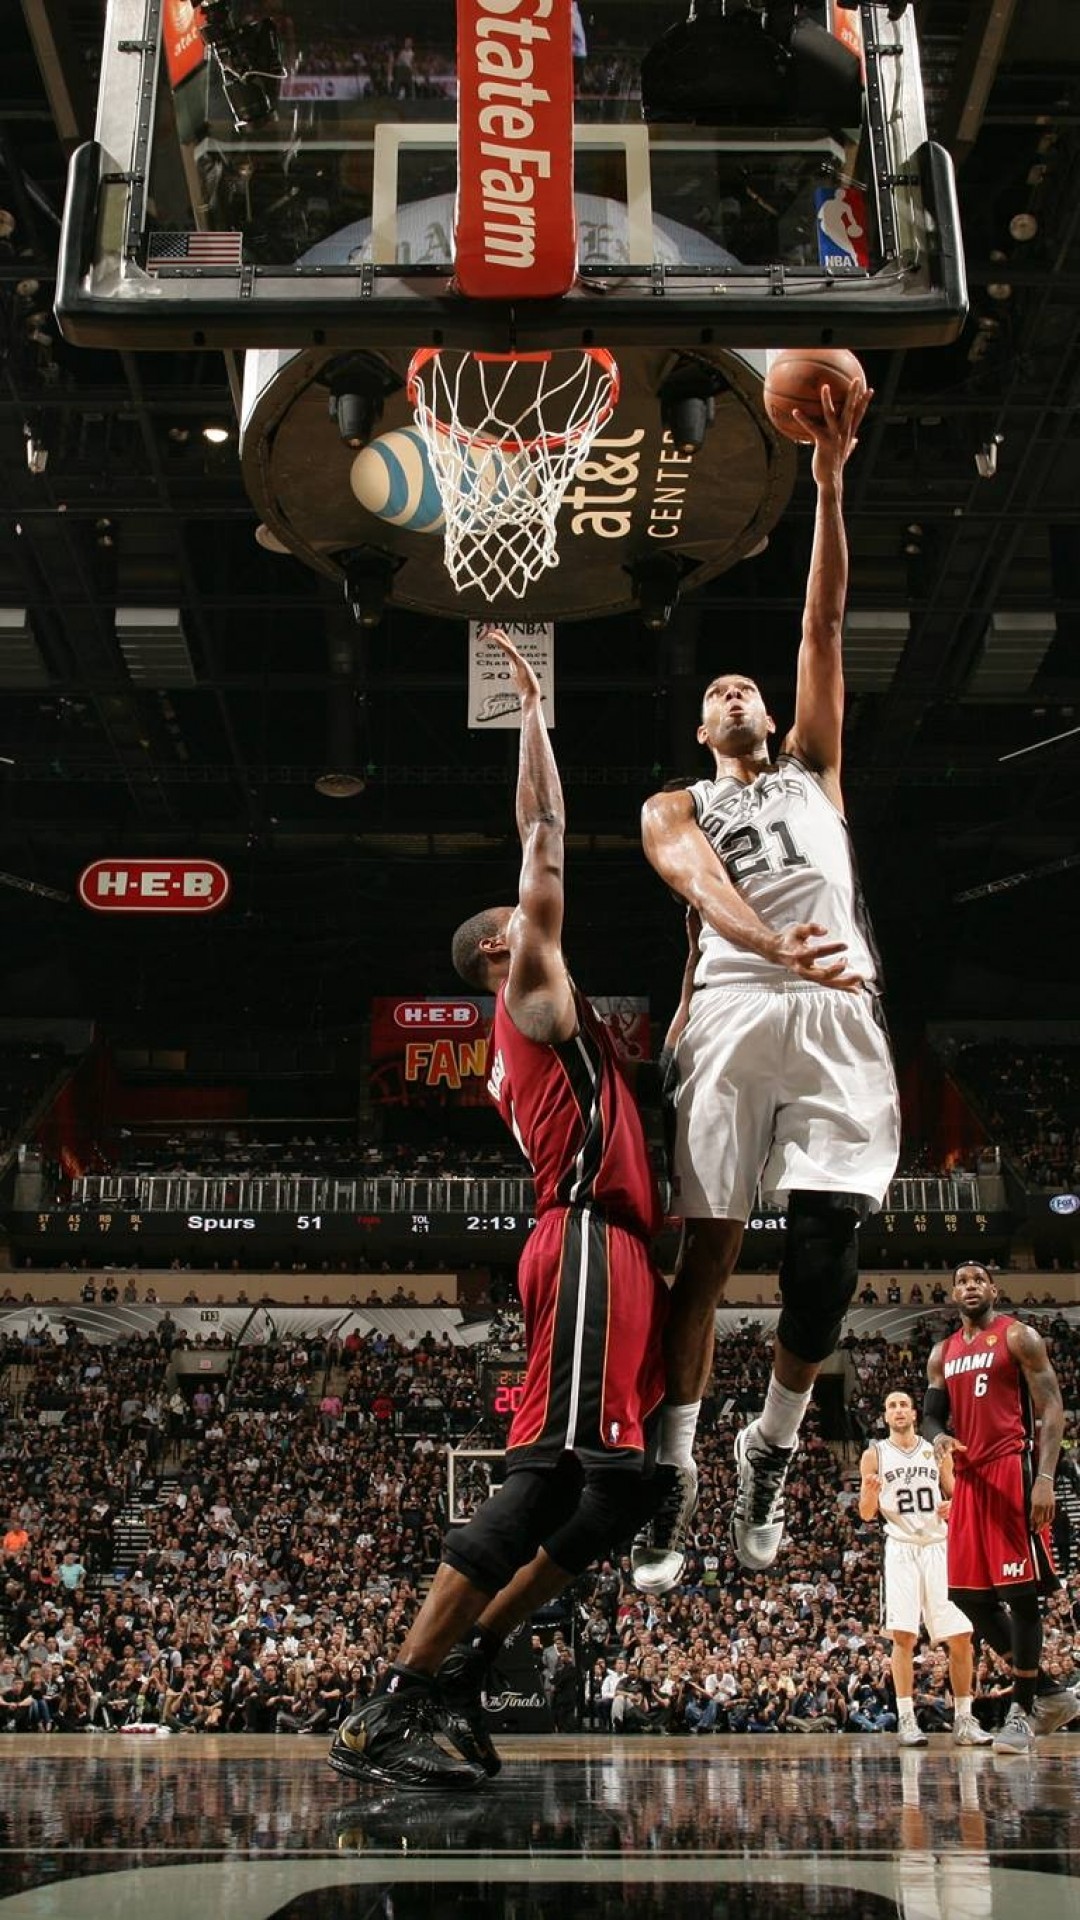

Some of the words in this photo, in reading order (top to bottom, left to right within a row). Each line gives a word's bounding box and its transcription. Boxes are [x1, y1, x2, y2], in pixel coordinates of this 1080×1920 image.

[825, 255, 852, 267] NBA
[562, 429, 645, 538] at&t
[717, 820, 812, 884] 21
[68, 1214, 81, 1222] AS
[131, 1214, 142, 1223] BL
[187, 1215, 256, 1232] Spurs
[296, 1216, 322, 1229] 51
[411, 1215, 430, 1224] TOL
[466, 1216, 517, 1230] 2:13
[744, 1216, 788, 1230] eat
[885, 1215, 896, 1223] ST
[914, 1215, 927, 1223] AS
[945, 1215, 957, 1223] RB
[976, 1215, 988, 1224] BL
[69, 1224, 80, 1232] 12
[411, 1225, 430, 1233] 4:1
[202, 1311, 219, 1321] 113
[944, 1352, 995, 1380] MIAMI
[974, 1373, 989, 1398] 6
[884, 1466, 938, 1483] SPURS
[896, 1487, 935, 1514] 20
[499, 1691, 545, 1710] Finals
